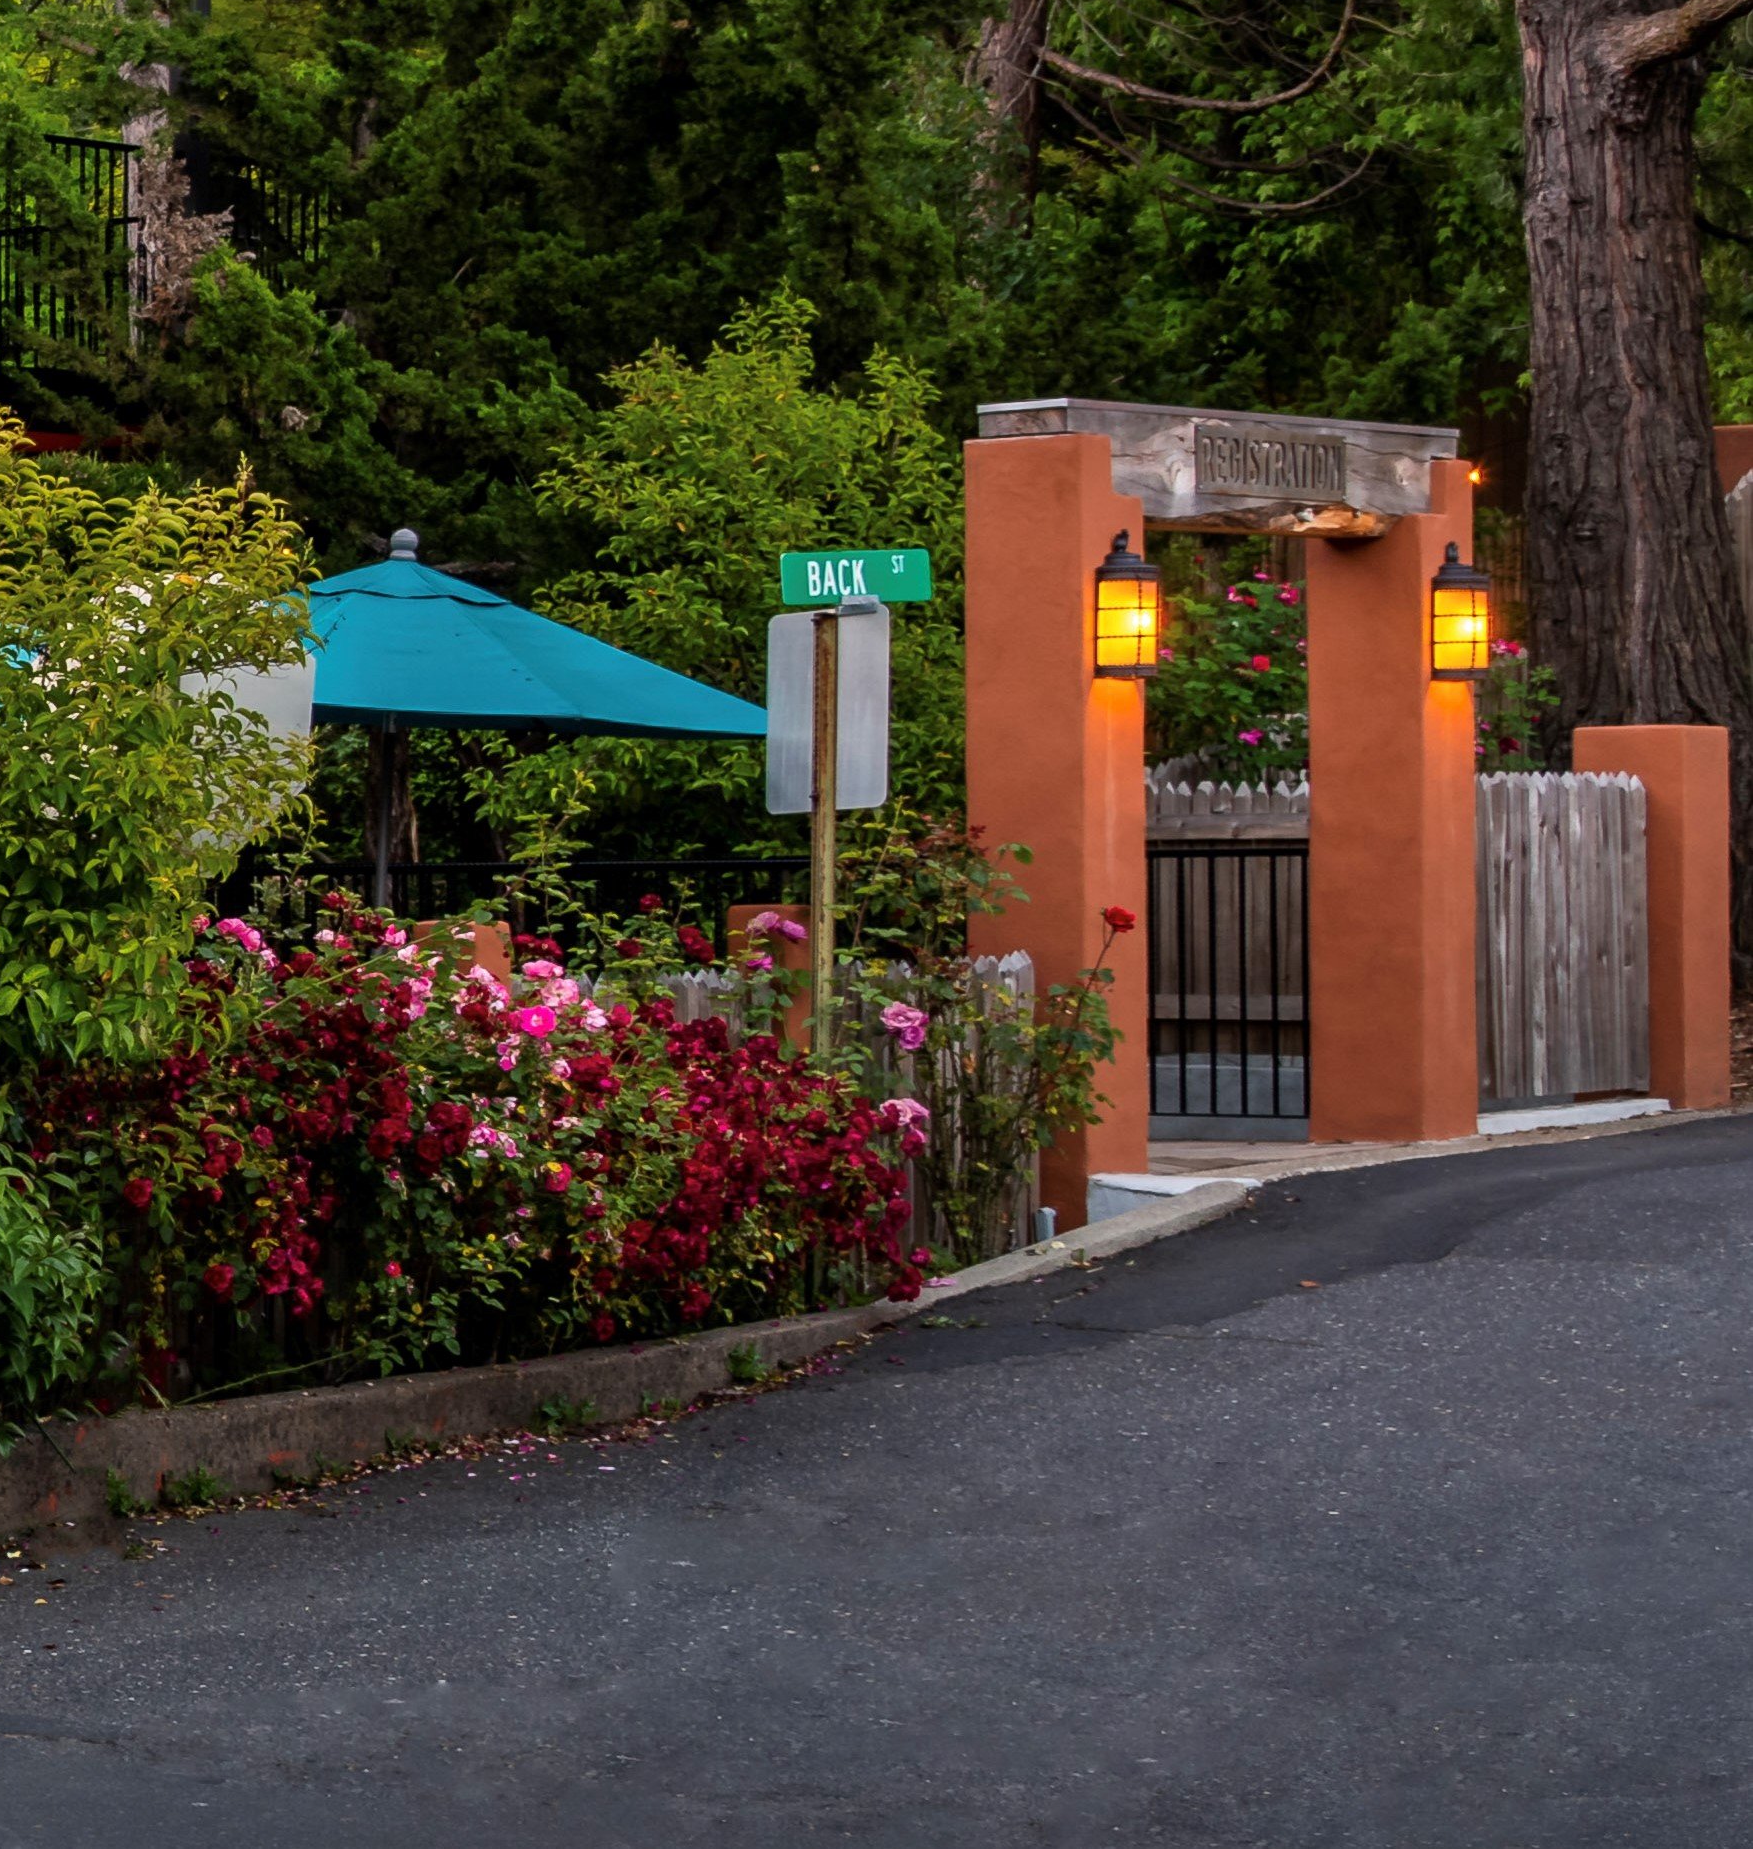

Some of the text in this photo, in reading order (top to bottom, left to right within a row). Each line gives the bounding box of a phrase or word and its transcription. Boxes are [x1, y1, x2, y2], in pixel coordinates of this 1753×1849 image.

[1201, 435, 1342, 492] REGISTRATION
[806, 554, 905, 596] BACK ST
